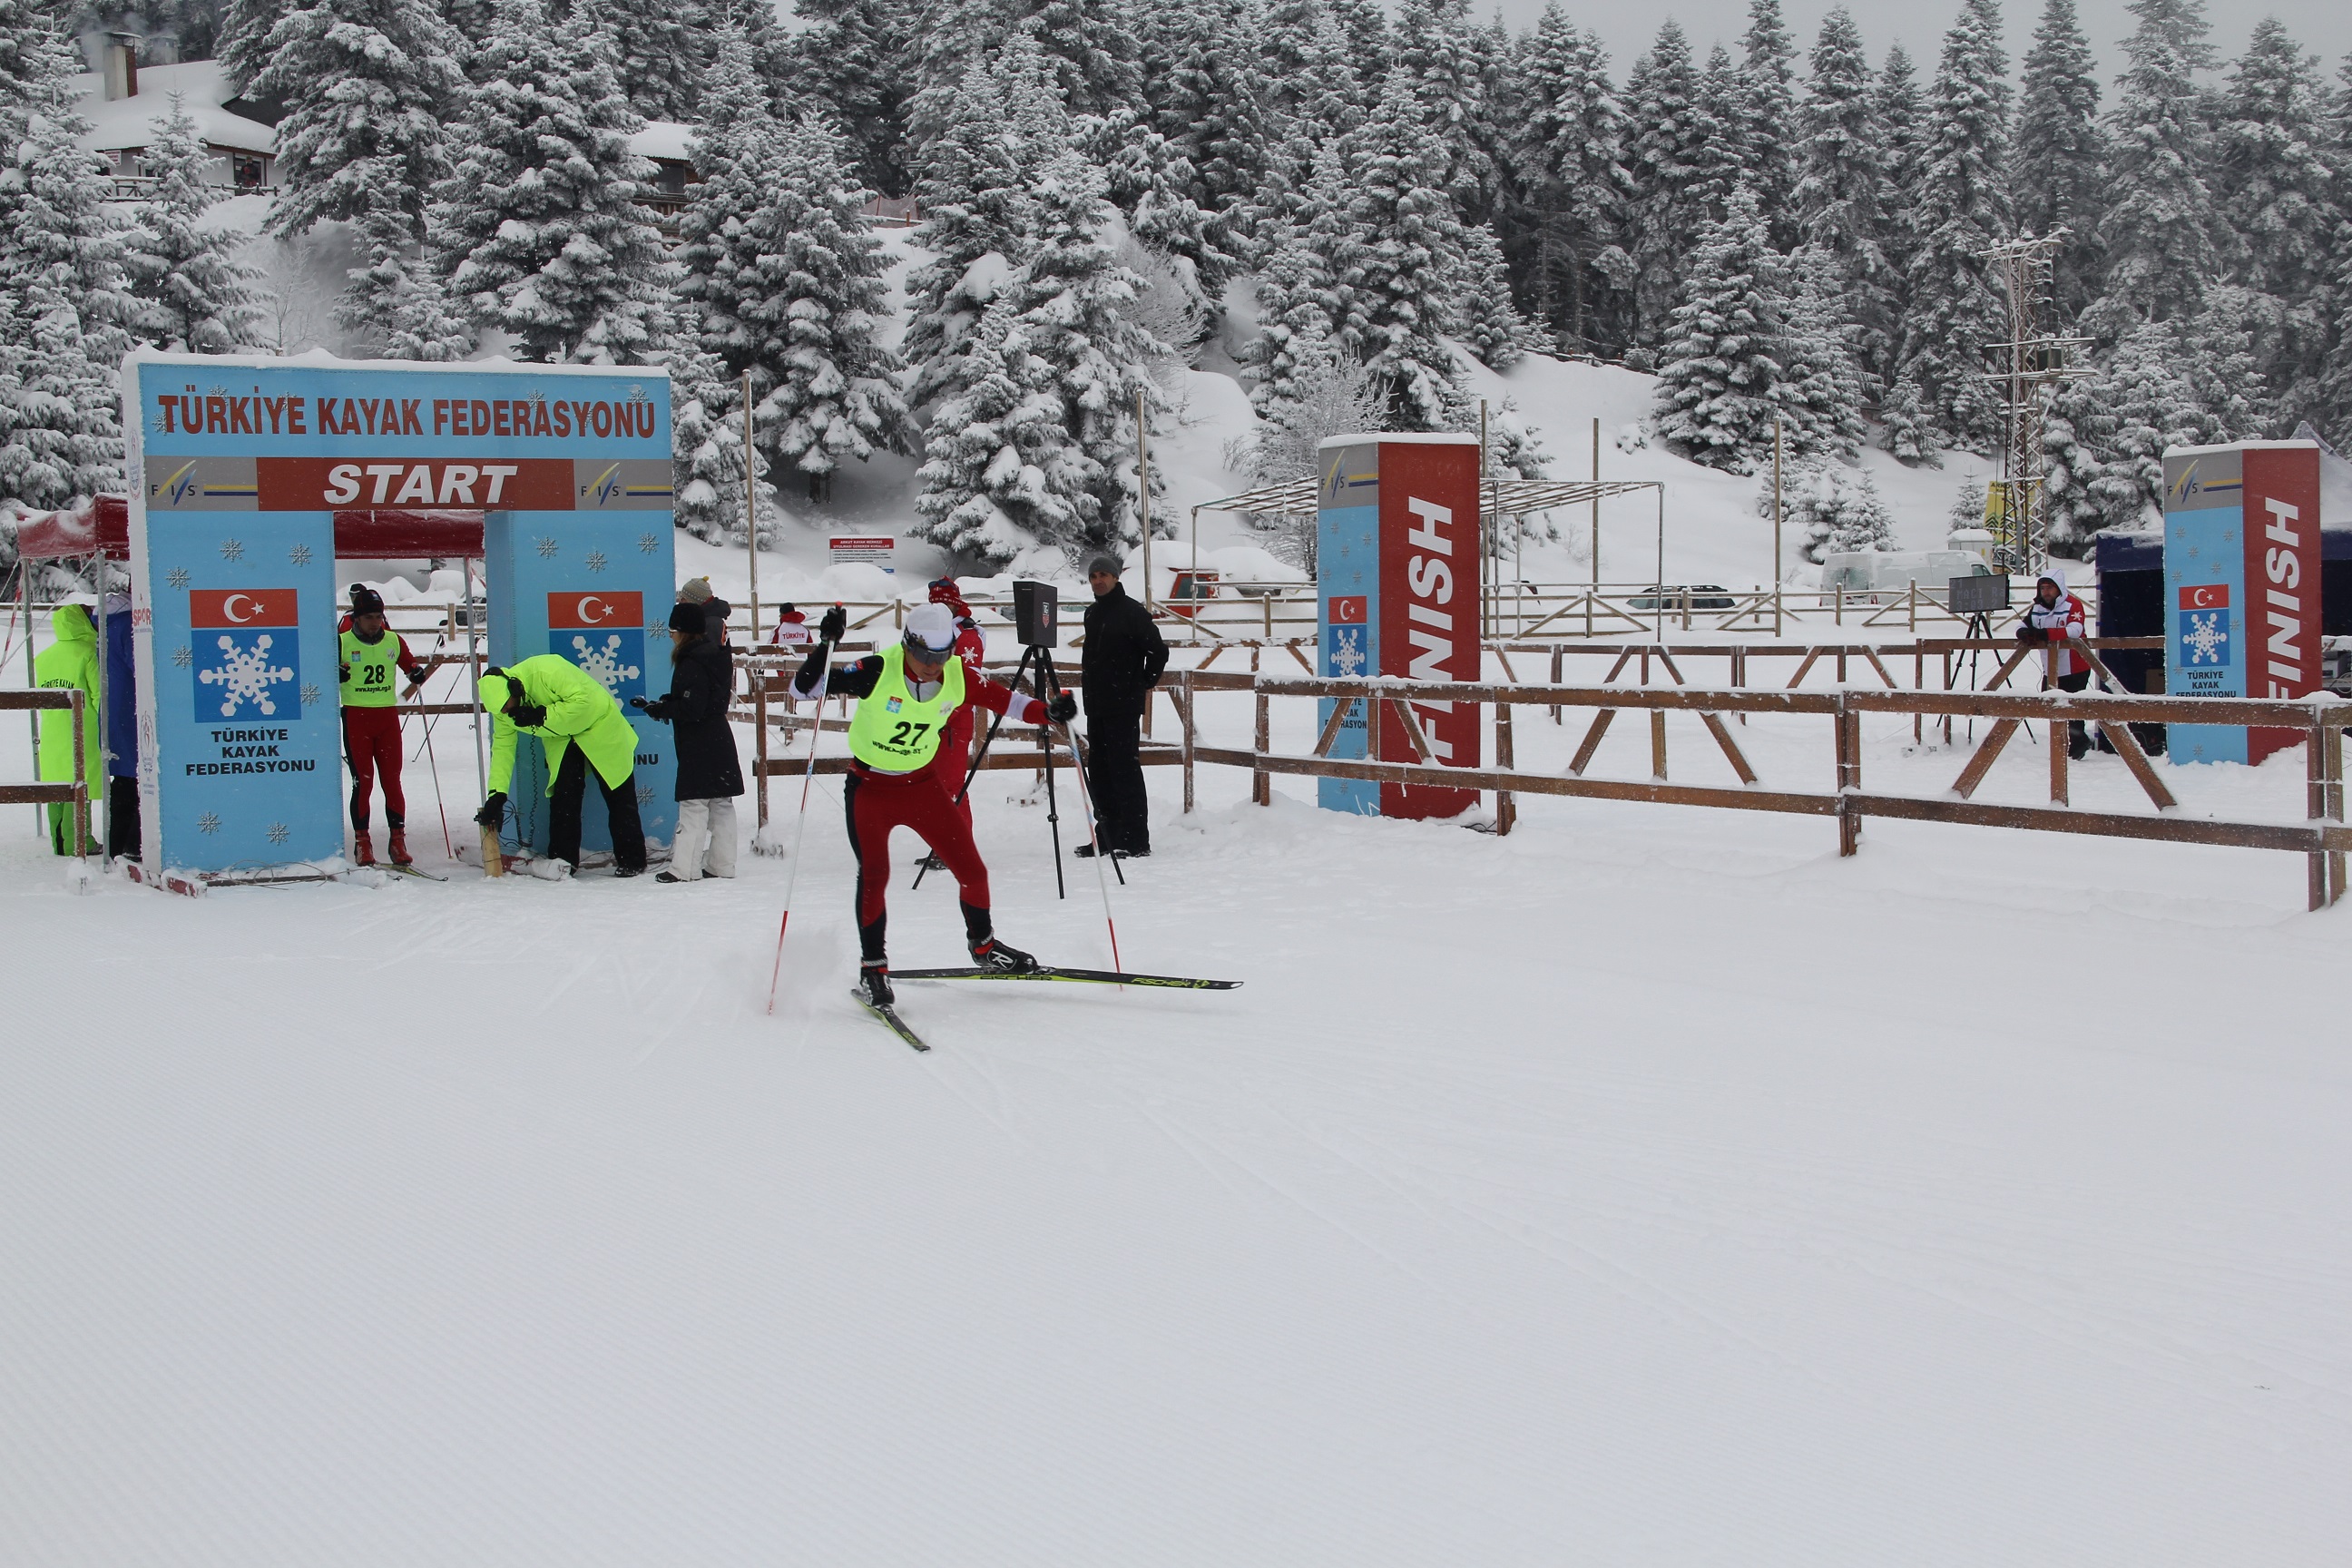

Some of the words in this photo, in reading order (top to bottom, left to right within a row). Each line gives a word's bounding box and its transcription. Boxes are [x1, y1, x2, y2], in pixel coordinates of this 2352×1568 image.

[158, 385, 307, 435] TÜRKİYE
[318, 397, 424, 436] KAYAK
[433, 399, 655, 438] FEDERASYONU
[151, 484, 196, 497] FIS
[323, 464, 518, 504] START
[581, 485, 620, 497] FIS
[1320, 476, 1345, 491] FIS
[2167, 483, 2198, 496] FIS
[132, 607, 152, 627] SPOR
[782, 632, 806, 640] TÜRKİYE
[363, 664, 386, 685] 28
[2186, 671, 2224, 680] TÜRKİYE
[2191, 681, 2220, 690] KAYAK
[1325, 720, 1367, 729] FRASYON
[211, 726, 289, 742] TÜRKİYE
[888, 721, 930, 746] 27
[221, 744, 280, 759] KAYAK
[185, 759, 316, 776] FEDERASYONU
[1131, 977, 1192, 987] FISCHER
